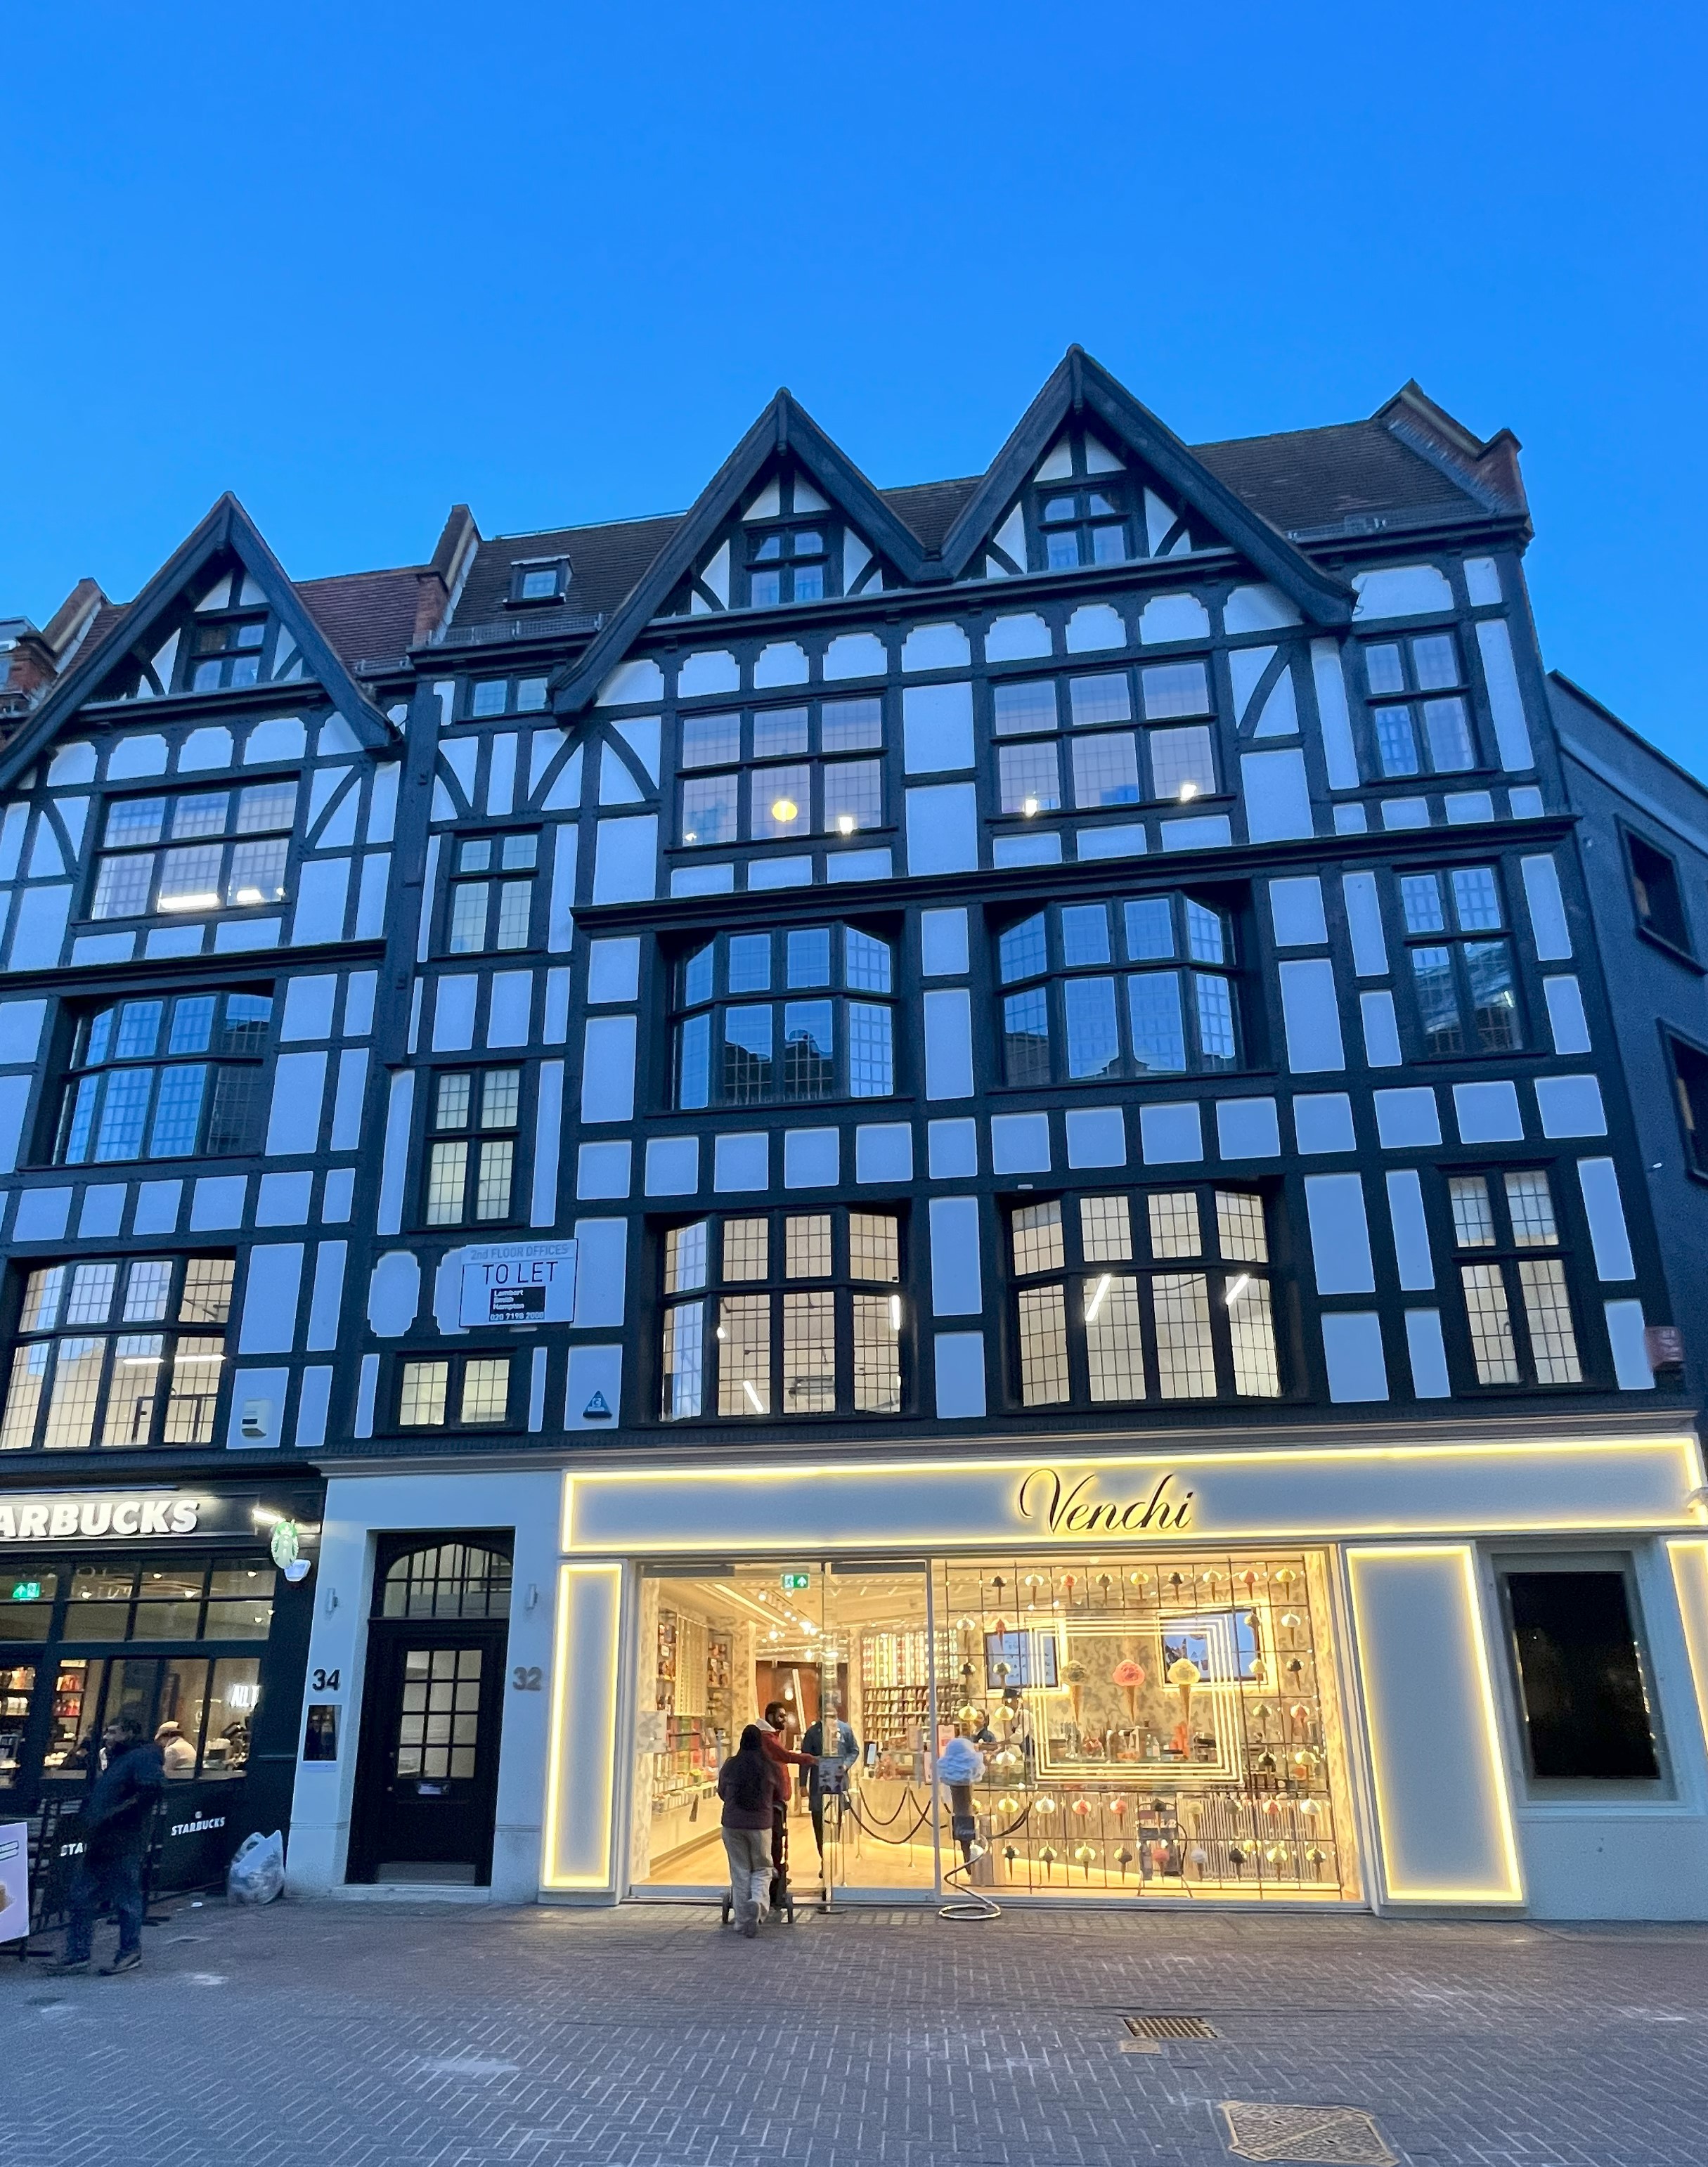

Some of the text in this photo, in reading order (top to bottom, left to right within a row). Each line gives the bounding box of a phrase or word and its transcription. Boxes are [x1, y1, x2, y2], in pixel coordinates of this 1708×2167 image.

[470, 1243, 569, 1260] 2nd FLOOR OFFICES
[482, 1261, 559, 1285] TO LET
[1019, 1468, 1193, 1534] Venchi
[312, 1669, 340, 1691] 34
[512, 1667, 543, 1690] 32
[171, 1817, 225, 1836] STARBUCKS
[60, 1842, 87, 1857] STA
